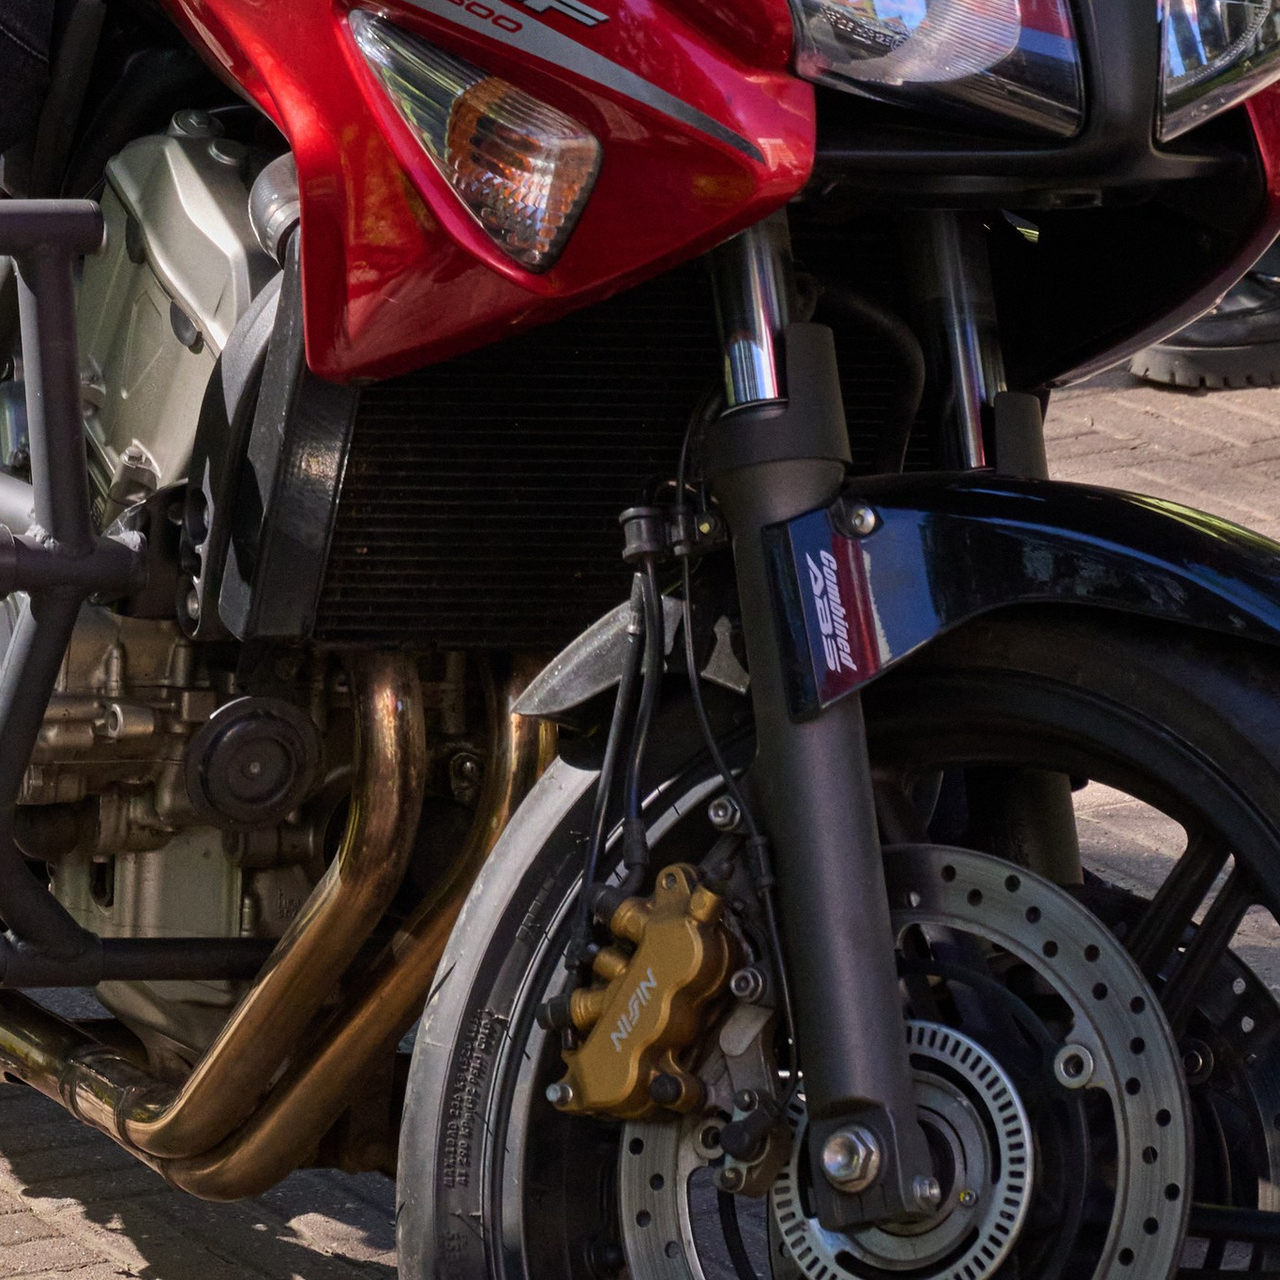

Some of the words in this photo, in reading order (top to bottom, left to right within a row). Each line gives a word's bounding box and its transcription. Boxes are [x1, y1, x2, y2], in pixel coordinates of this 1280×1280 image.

[805, 551, 841, 674] ABS
[820, 550, 857, 672] Combined
[610, 967, 657, 1053] NISSIN
[459, 1140, 469, 1166] 290
